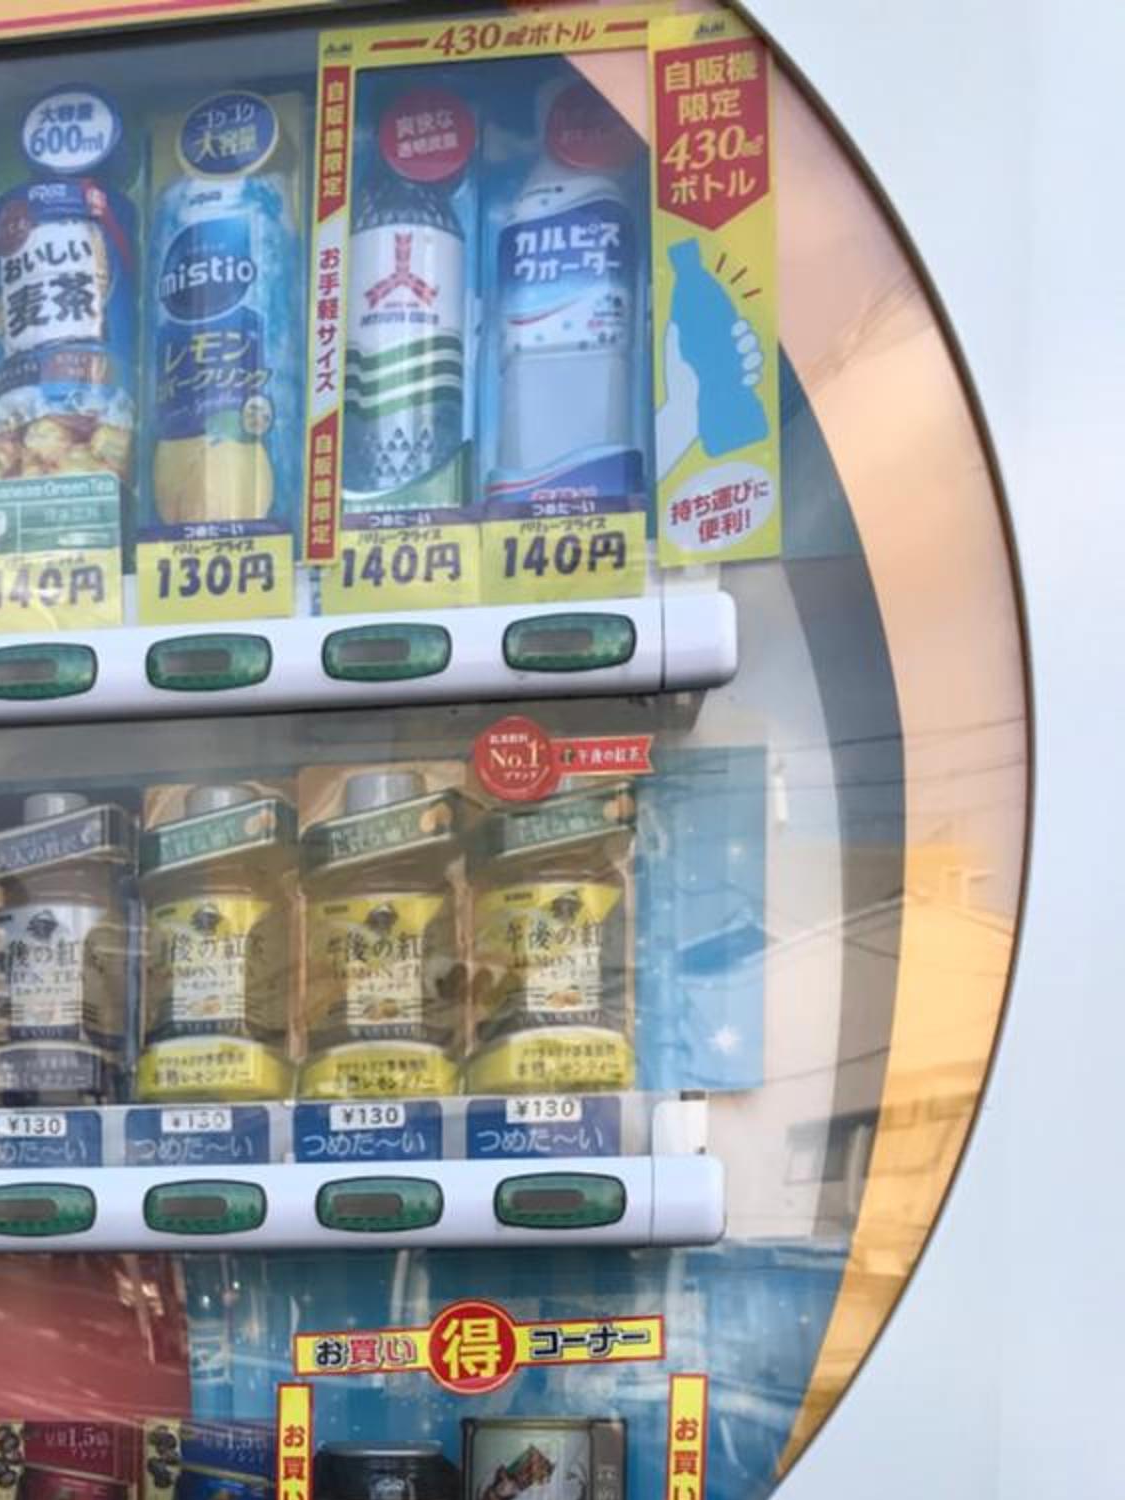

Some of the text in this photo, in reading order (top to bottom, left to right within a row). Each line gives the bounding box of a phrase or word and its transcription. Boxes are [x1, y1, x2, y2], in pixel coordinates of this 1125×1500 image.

[664, 51, 759, 90] 自販機
[396, 107, 456, 139] 爽快な
[678, 89, 742, 121] 限定
[30, 125, 105, 156] 600ml
[194, 125, 258, 162] 大容量
[672, 168, 755, 205] ボトル
[515, 220, 622, 257] カルピス
[3, 240, 93, 284] おいしい
[159, 255, 257, 295] mistio
[7, 272, 97, 338] 麦茶
[313, 249, 341, 392] お手軽サイズ
[671, 480, 771, 525] 持ち運びに
[698, 510, 753, 545] 便利!
[341, 541, 462, 588] 140円
[504, 530, 628, 578] 140円
[157, 553, 275, 599] 130円
[489, 739, 540, 769] No.1
[8, 1117, 62, 1136] ¥130
[342, 1106, 399, 1126] ¥130
[516, 1101, 575, 1119] ¥130
[315, 1317, 651, 1380] お買い 得 コーナー
